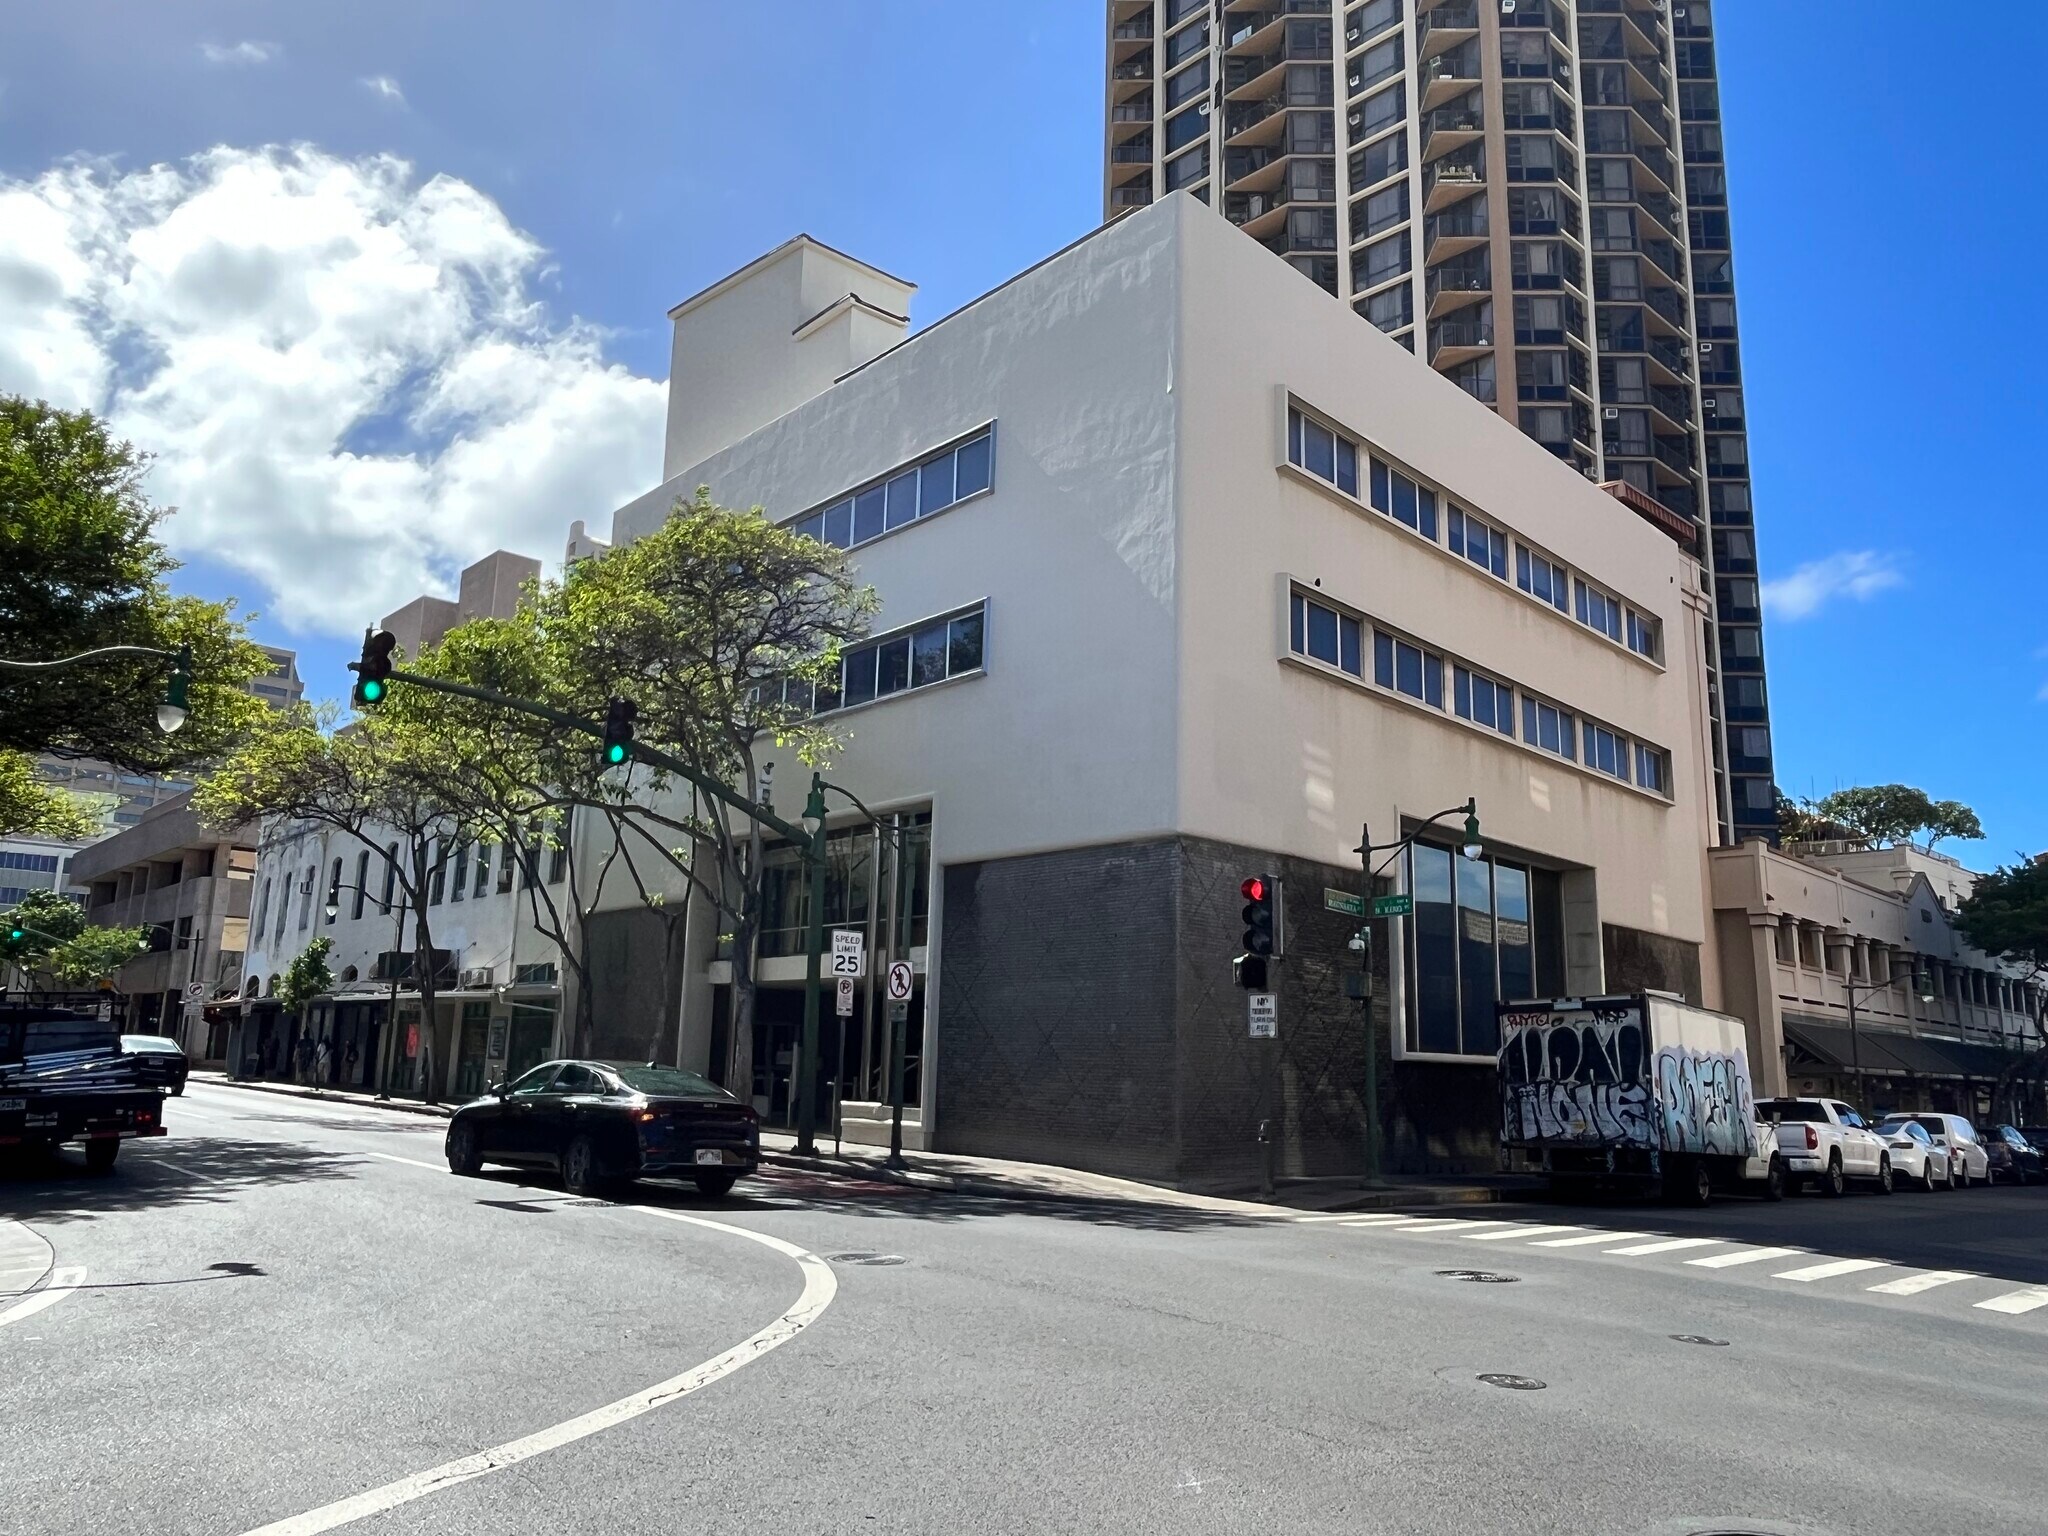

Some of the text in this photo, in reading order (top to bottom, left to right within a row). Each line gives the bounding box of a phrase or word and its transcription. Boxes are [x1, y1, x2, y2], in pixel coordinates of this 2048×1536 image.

[835, 935, 861, 944] SPEED
[836, 945, 857, 953] LIMIT
[834, 955, 858, 973] 25
